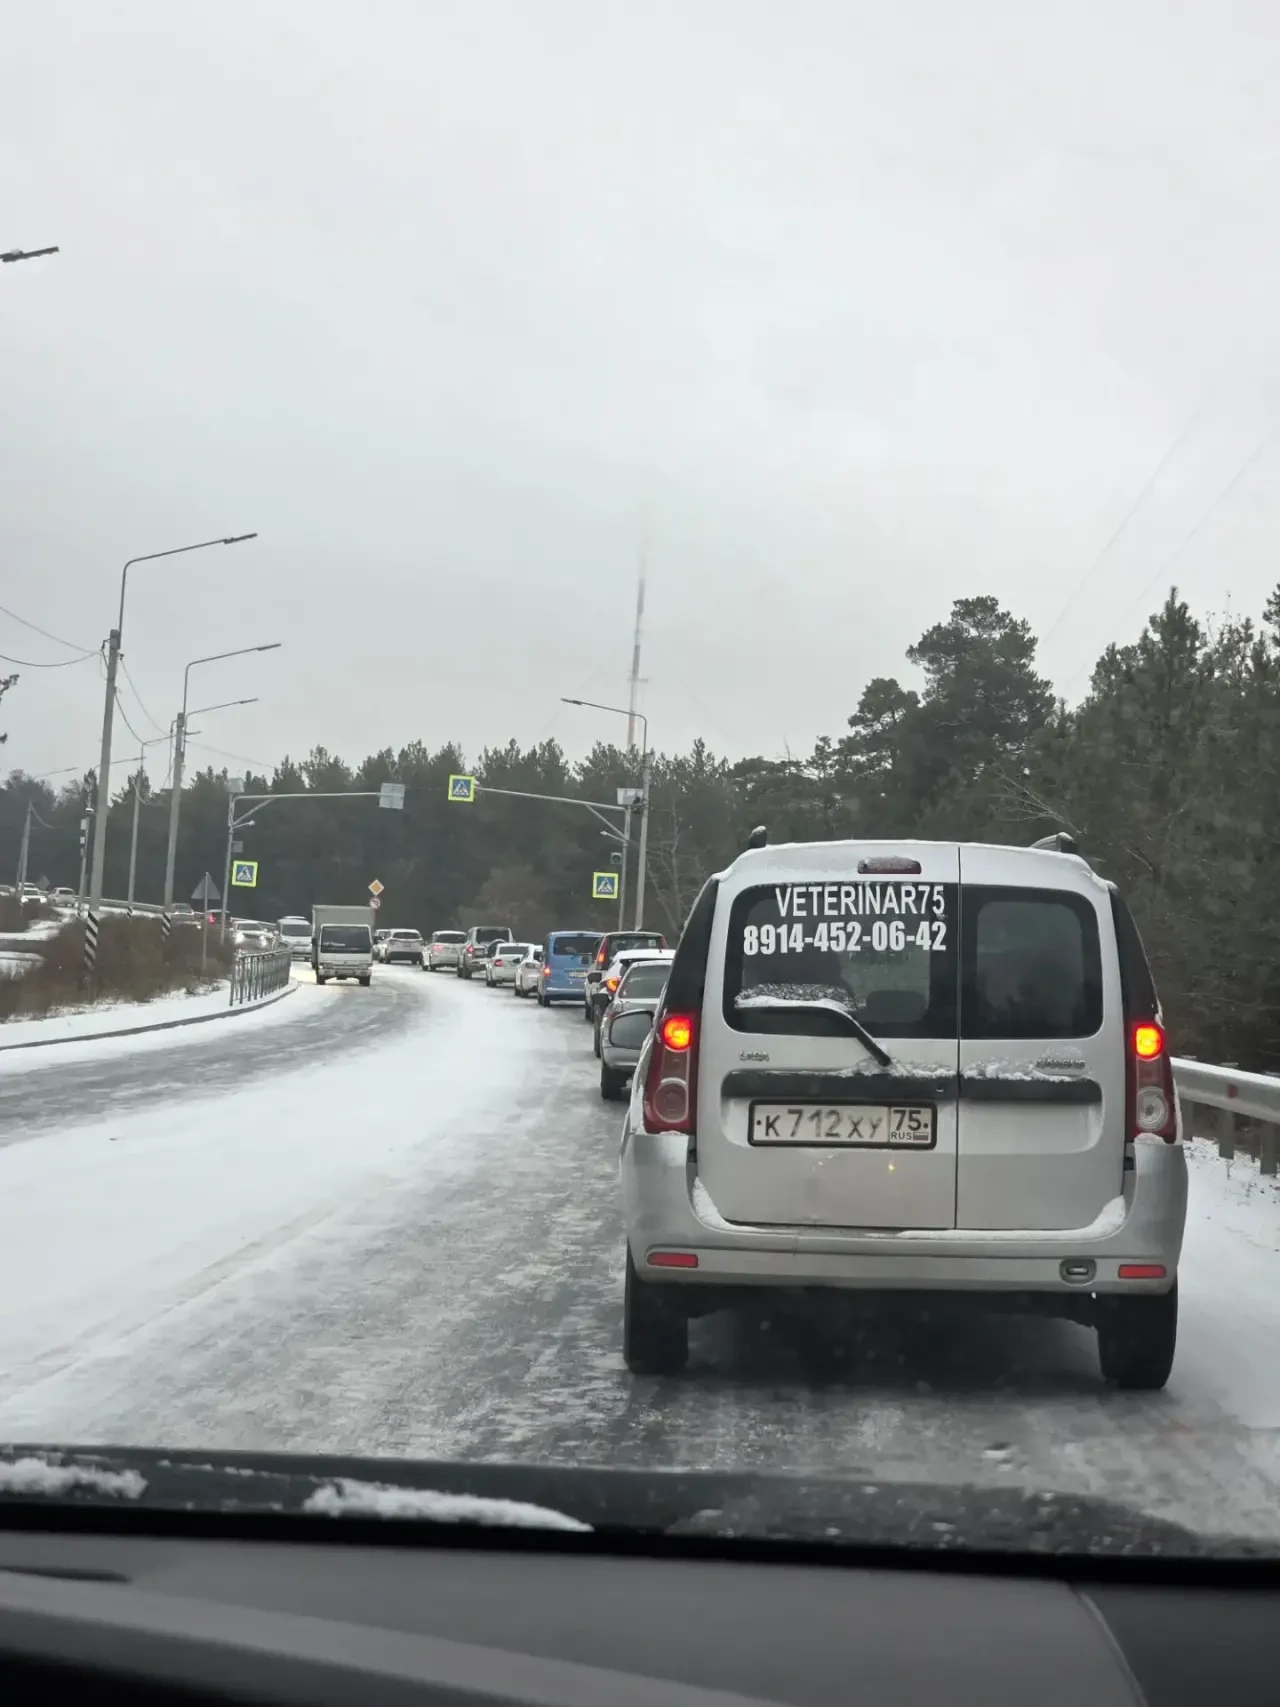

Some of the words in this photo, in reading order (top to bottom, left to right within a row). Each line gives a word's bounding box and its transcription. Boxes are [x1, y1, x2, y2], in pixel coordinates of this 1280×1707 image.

[775, 885, 945, 917] VETERINAR75
[743, 921, 947, 955] 8914-452-06-42
[890, 1131, 913, 1140] RUS
